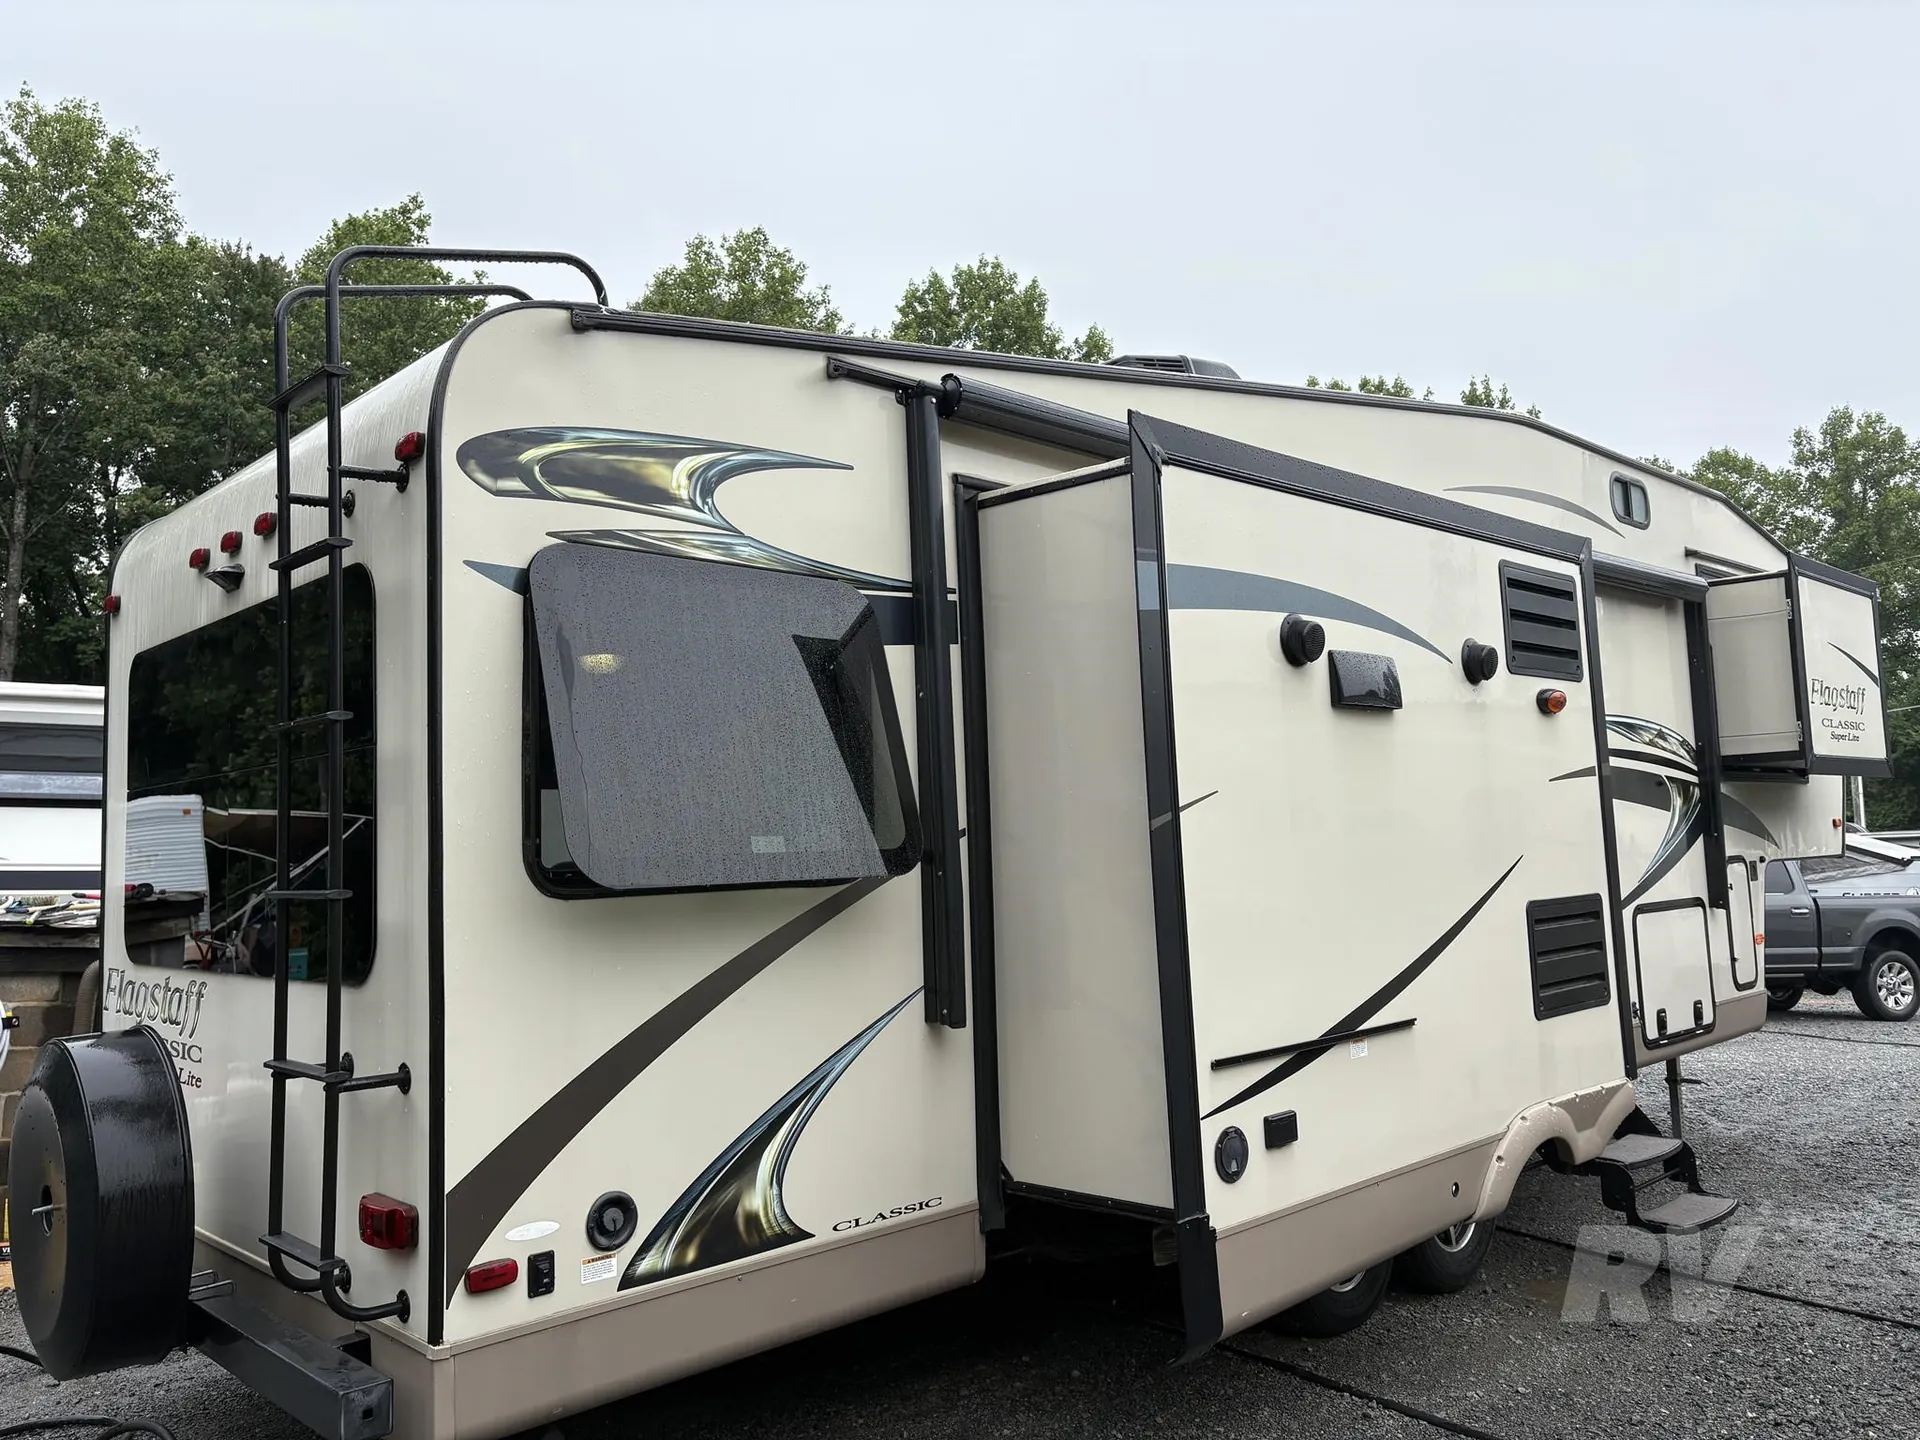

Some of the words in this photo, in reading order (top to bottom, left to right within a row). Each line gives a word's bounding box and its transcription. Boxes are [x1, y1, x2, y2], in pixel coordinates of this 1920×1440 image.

[1810, 678, 1866, 715] Flagstaff
[1821, 718, 1866, 731] CLASSIC
[1830, 731, 1847, 742] Super
[1847, 733, 1860, 742] Lite
[103, 967, 207, 1039] Flagstaff
[178, 1067, 202, 1088] Lite
[831, 1196, 943, 1232] CLASSIC
